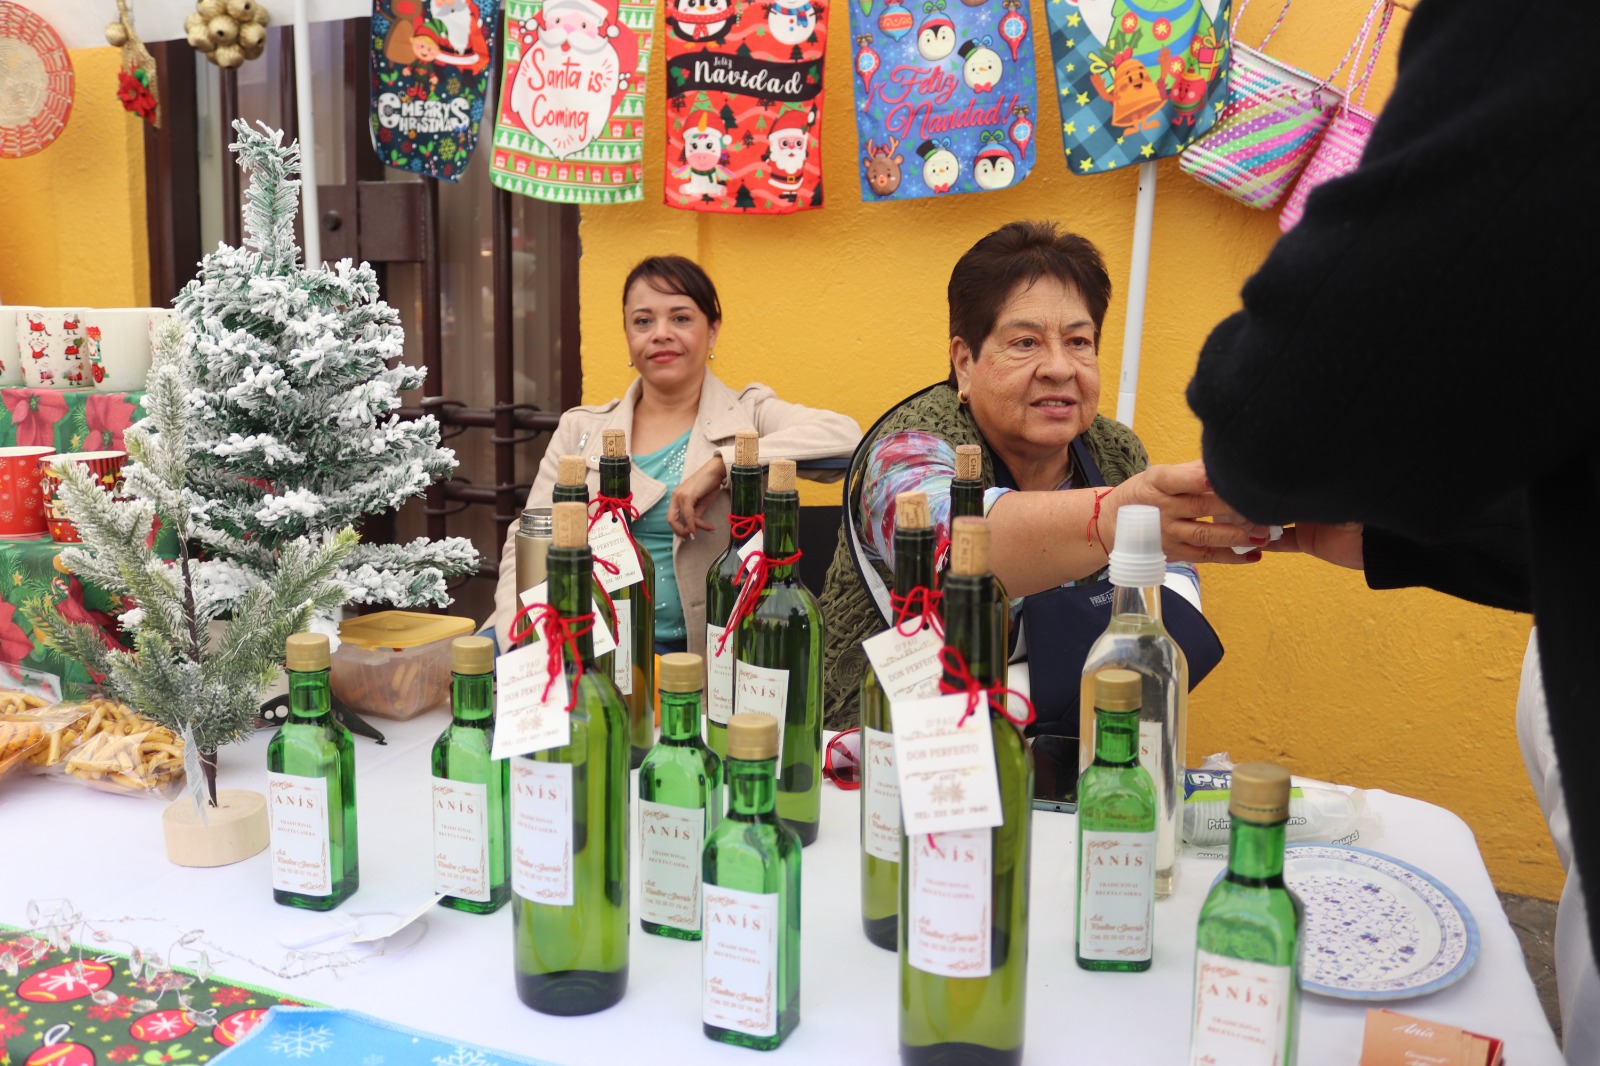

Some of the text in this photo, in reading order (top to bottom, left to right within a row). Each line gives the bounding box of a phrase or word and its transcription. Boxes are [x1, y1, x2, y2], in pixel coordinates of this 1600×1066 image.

[528, 47, 603, 93] Santa is
[694, 60, 803, 94] Navidad
[531, 94, 589, 142] Coming
[885, 93, 1020, 140] Navidad!
[906, 744, 980, 761] DON PERFECTO
[516, 784, 557, 800] ANÍS
[275, 795, 314, 809] ANÍS
[436, 800, 474, 814] ANÍS
[648, 825, 690, 840] ANÍS
[1094, 852, 1143, 866] ANÍS
[712, 913, 761, 931] ANÍS
